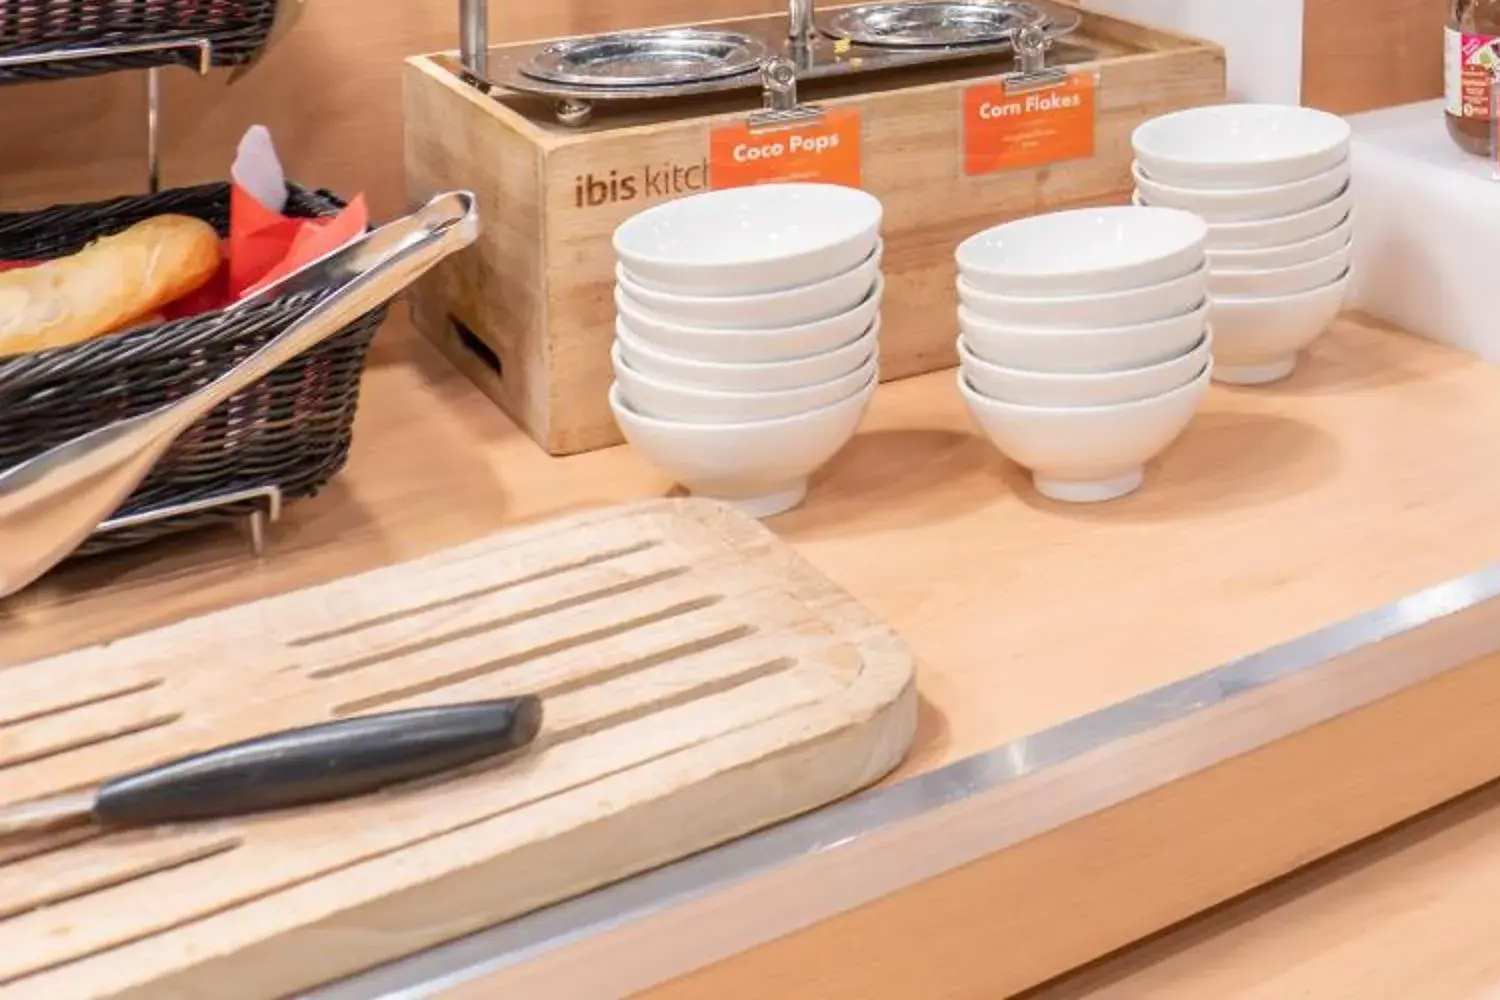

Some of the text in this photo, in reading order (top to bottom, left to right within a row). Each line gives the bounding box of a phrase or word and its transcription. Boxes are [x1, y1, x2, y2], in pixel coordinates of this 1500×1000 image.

[979, 90, 1081, 119] Corn Flakes
[733, 133, 839, 162] Coco Pops
[575, 170, 637, 208] ibis
